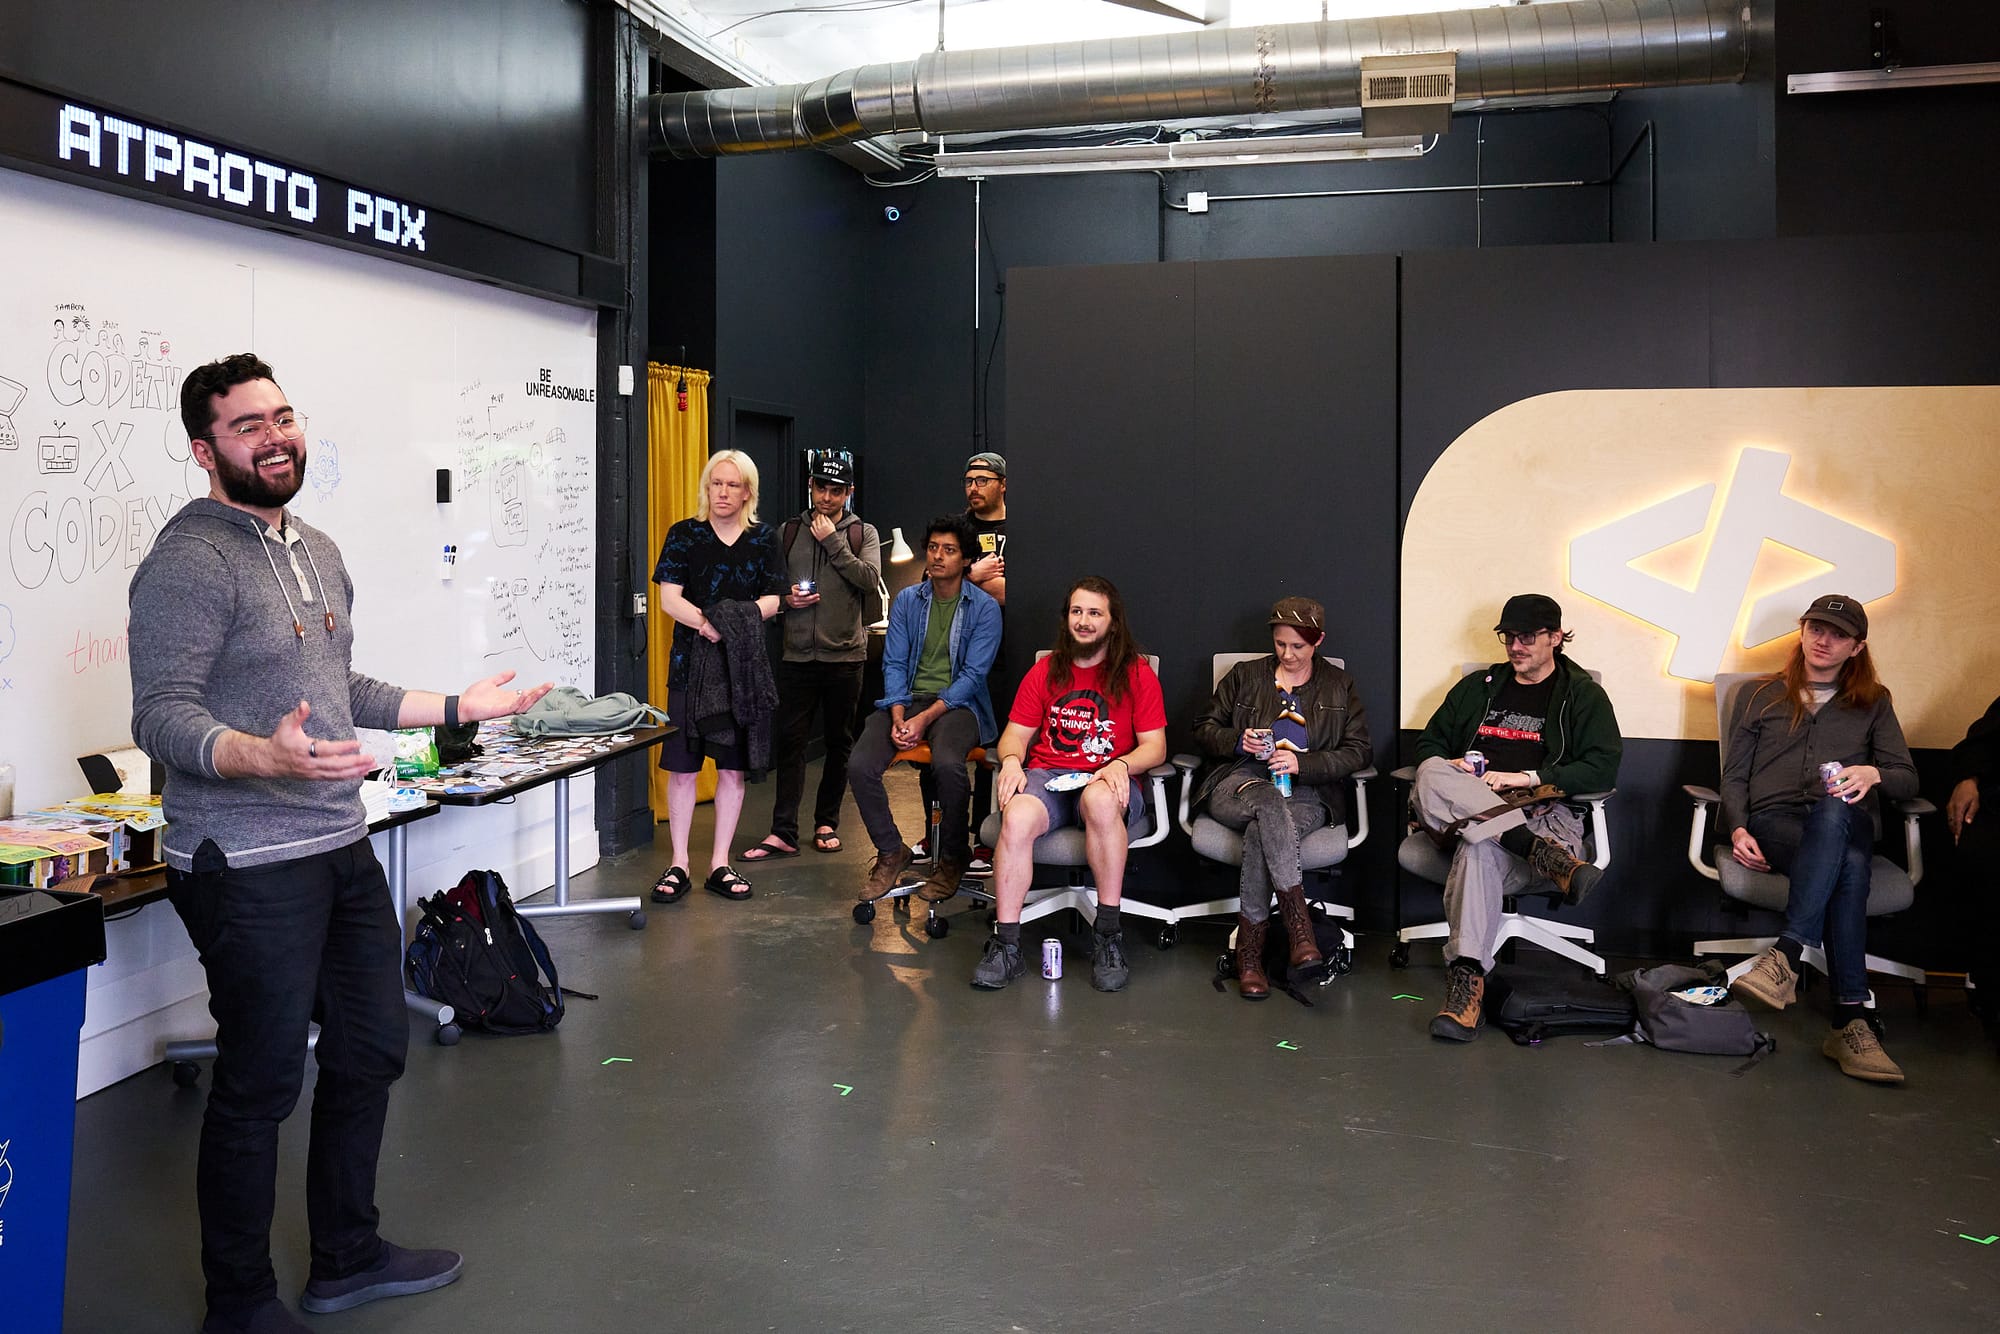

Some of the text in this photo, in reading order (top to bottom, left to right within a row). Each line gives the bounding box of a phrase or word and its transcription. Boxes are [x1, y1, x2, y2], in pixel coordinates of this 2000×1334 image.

[58, 103, 426, 251] ATPROTO PDX
[539, 368, 552, 383] BE
[526, 382, 595, 403] UNREASONABLE
[1061, 708, 1077, 716] CAN
[1060, 719, 1092, 730] THINGS
